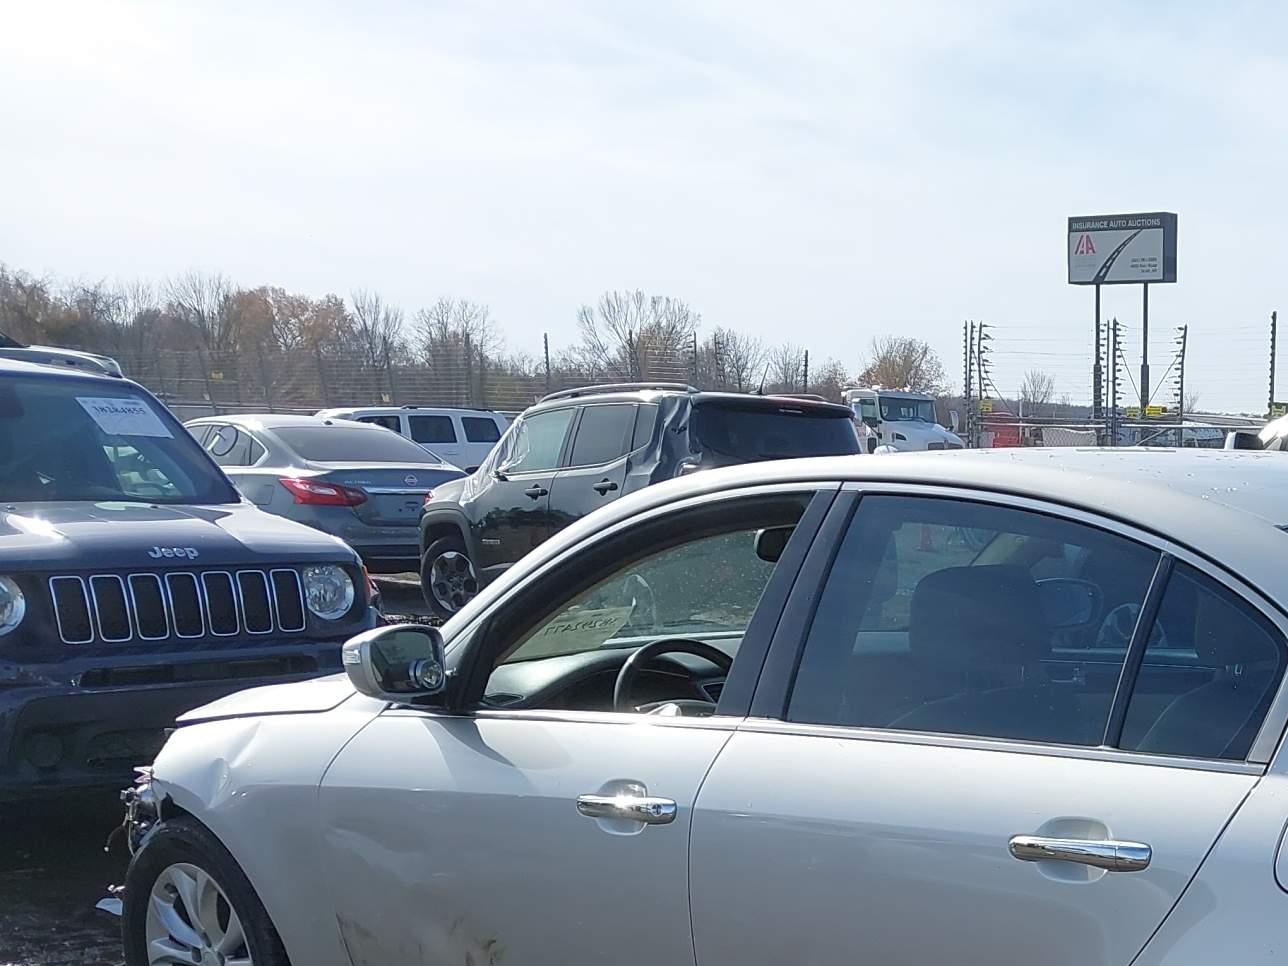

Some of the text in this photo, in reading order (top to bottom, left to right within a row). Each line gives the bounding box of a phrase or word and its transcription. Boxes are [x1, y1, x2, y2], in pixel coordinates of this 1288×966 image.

[1072, 218, 1161, 229] INSURANCE AUTO AUCTIONS
[147, 546, 199, 560] Jeep
